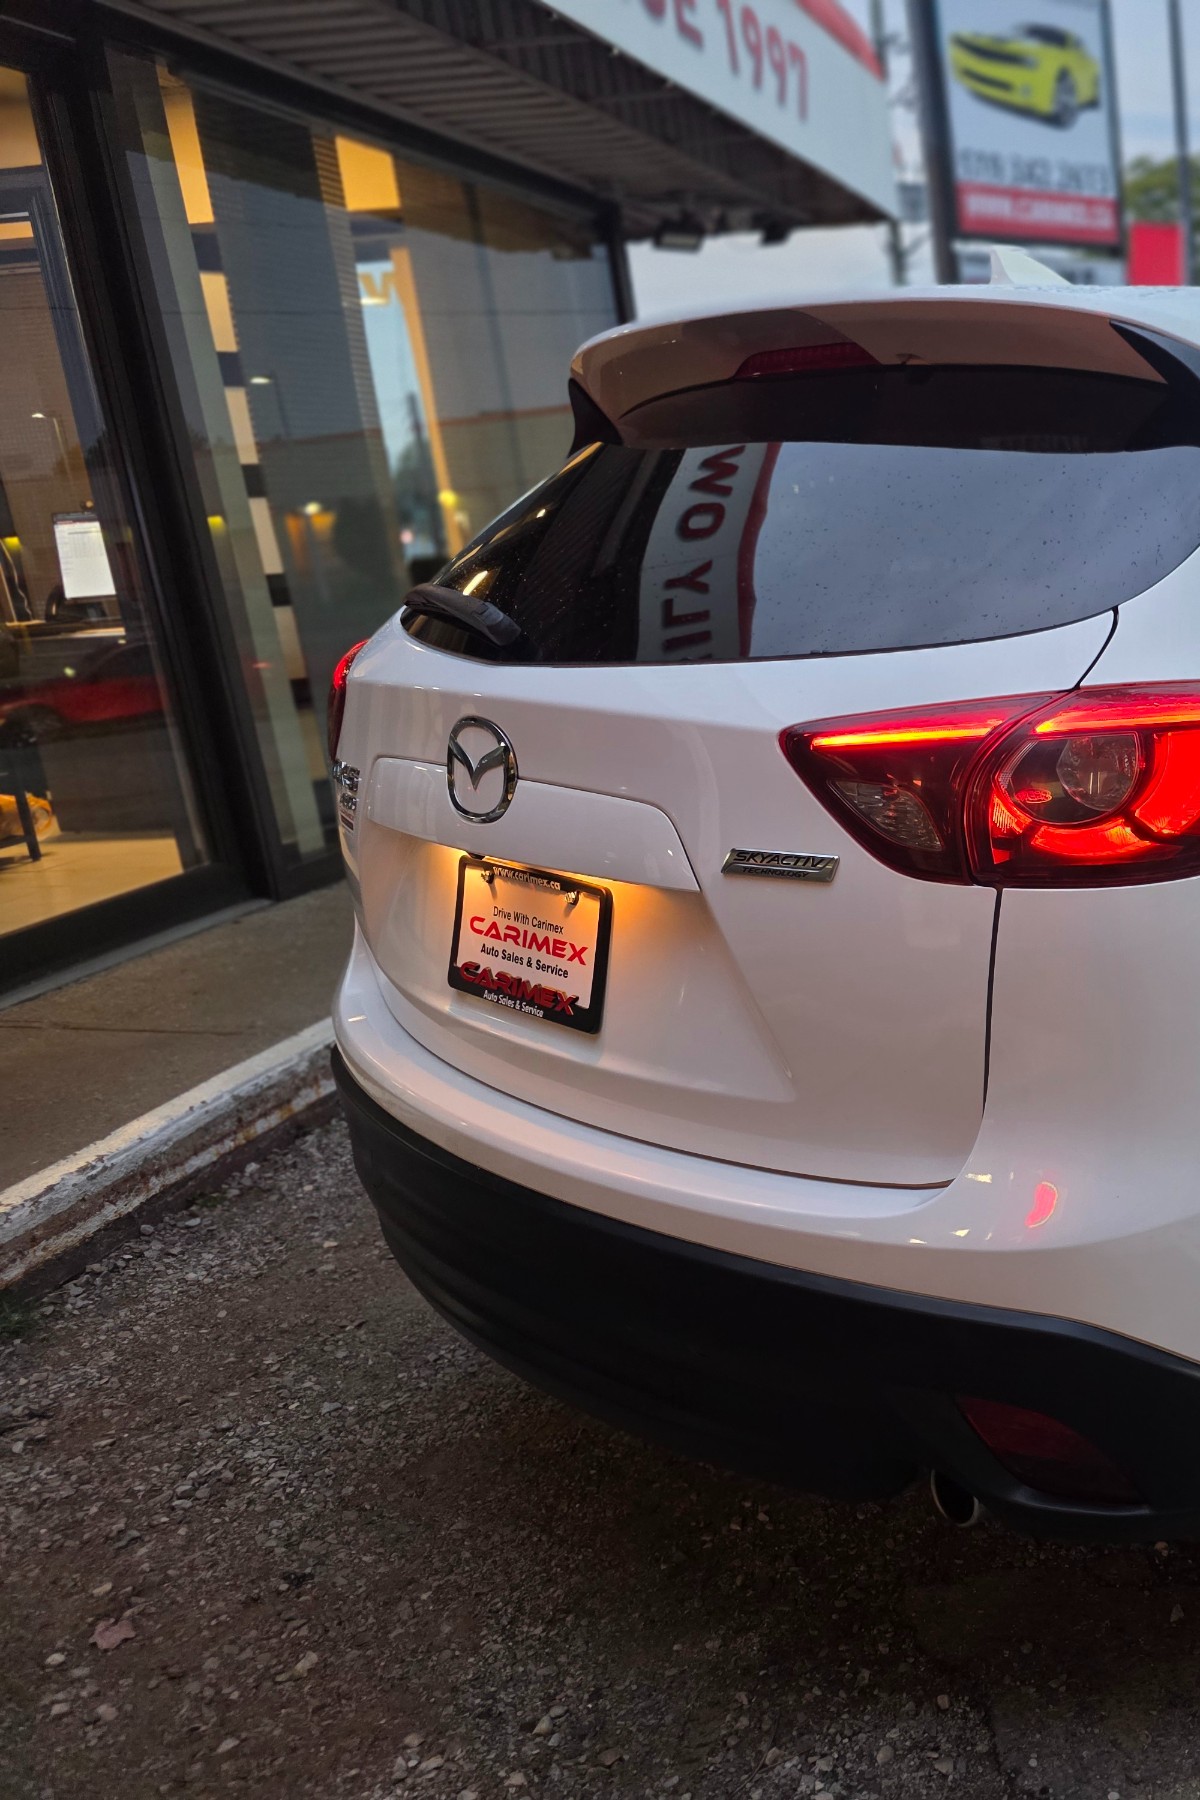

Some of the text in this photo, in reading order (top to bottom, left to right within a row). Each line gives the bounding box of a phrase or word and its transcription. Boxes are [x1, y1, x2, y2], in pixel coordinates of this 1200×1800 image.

[716, 0, 808, 122] 1997
[733, 851, 827, 868] SKYACTIV
[742, 866, 810, 878] TECHNOLOGY
[493, 866, 561, 891] www.carimex.ca
[493, 906, 564, 935] Drive With Carimex
[469, 916, 588, 966] CARIMEX
[480, 943, 569, 979] Auto Sales & Service
[459, 961, 579, 1016] CARIMEX
[483, 990, 498, 1002] Auto
[499, 995, 515, 1010] Sales
[521, 1002, 544, 1019] Service
